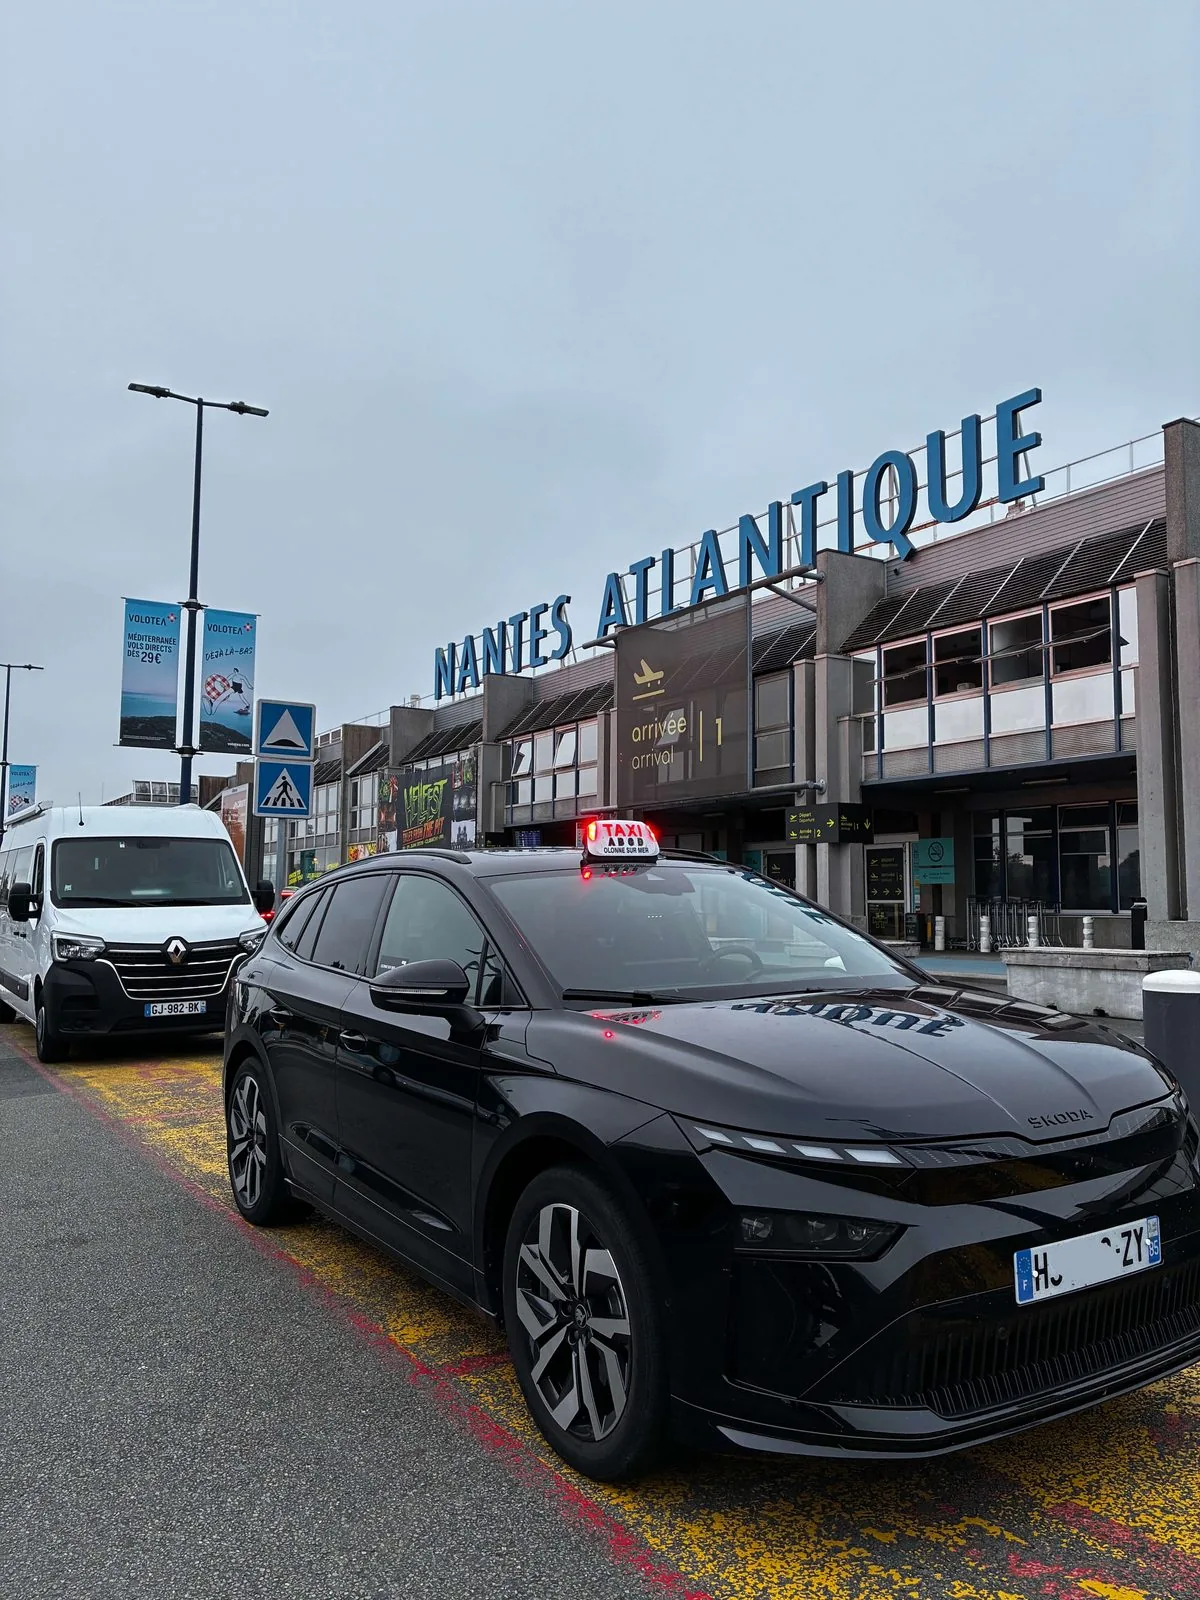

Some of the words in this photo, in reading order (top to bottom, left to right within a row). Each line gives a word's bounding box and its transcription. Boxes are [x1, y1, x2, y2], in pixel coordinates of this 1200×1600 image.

[434, 595, 572, 699] NANTES
[597, 388, 1045, 639] ATLANTIQUE
[128, 614, 167, 626] VOLOTEA
[207, 624, 243, 635] VOLOTEA
[128, 632, 177, 646] MÉDITERRANÉE
[127, 641, 144, 650] VOLS
[145, 643, 172, 654] DIRECTS
[141, 651, 162, 664] 29€
[632, 712, 687, 742] arrivée
[715, 717, 722, 746] 1
[632, 745, 674, 769] arrival
[602, 824, 642, 837] TAXI
[816, 829, 821, 837] 2
[152, 1002, 200, 1015] GJ-982-BK
[1149, 1239, 1159, 1257] 85
[1023, 1279, 1029, 1291] F
